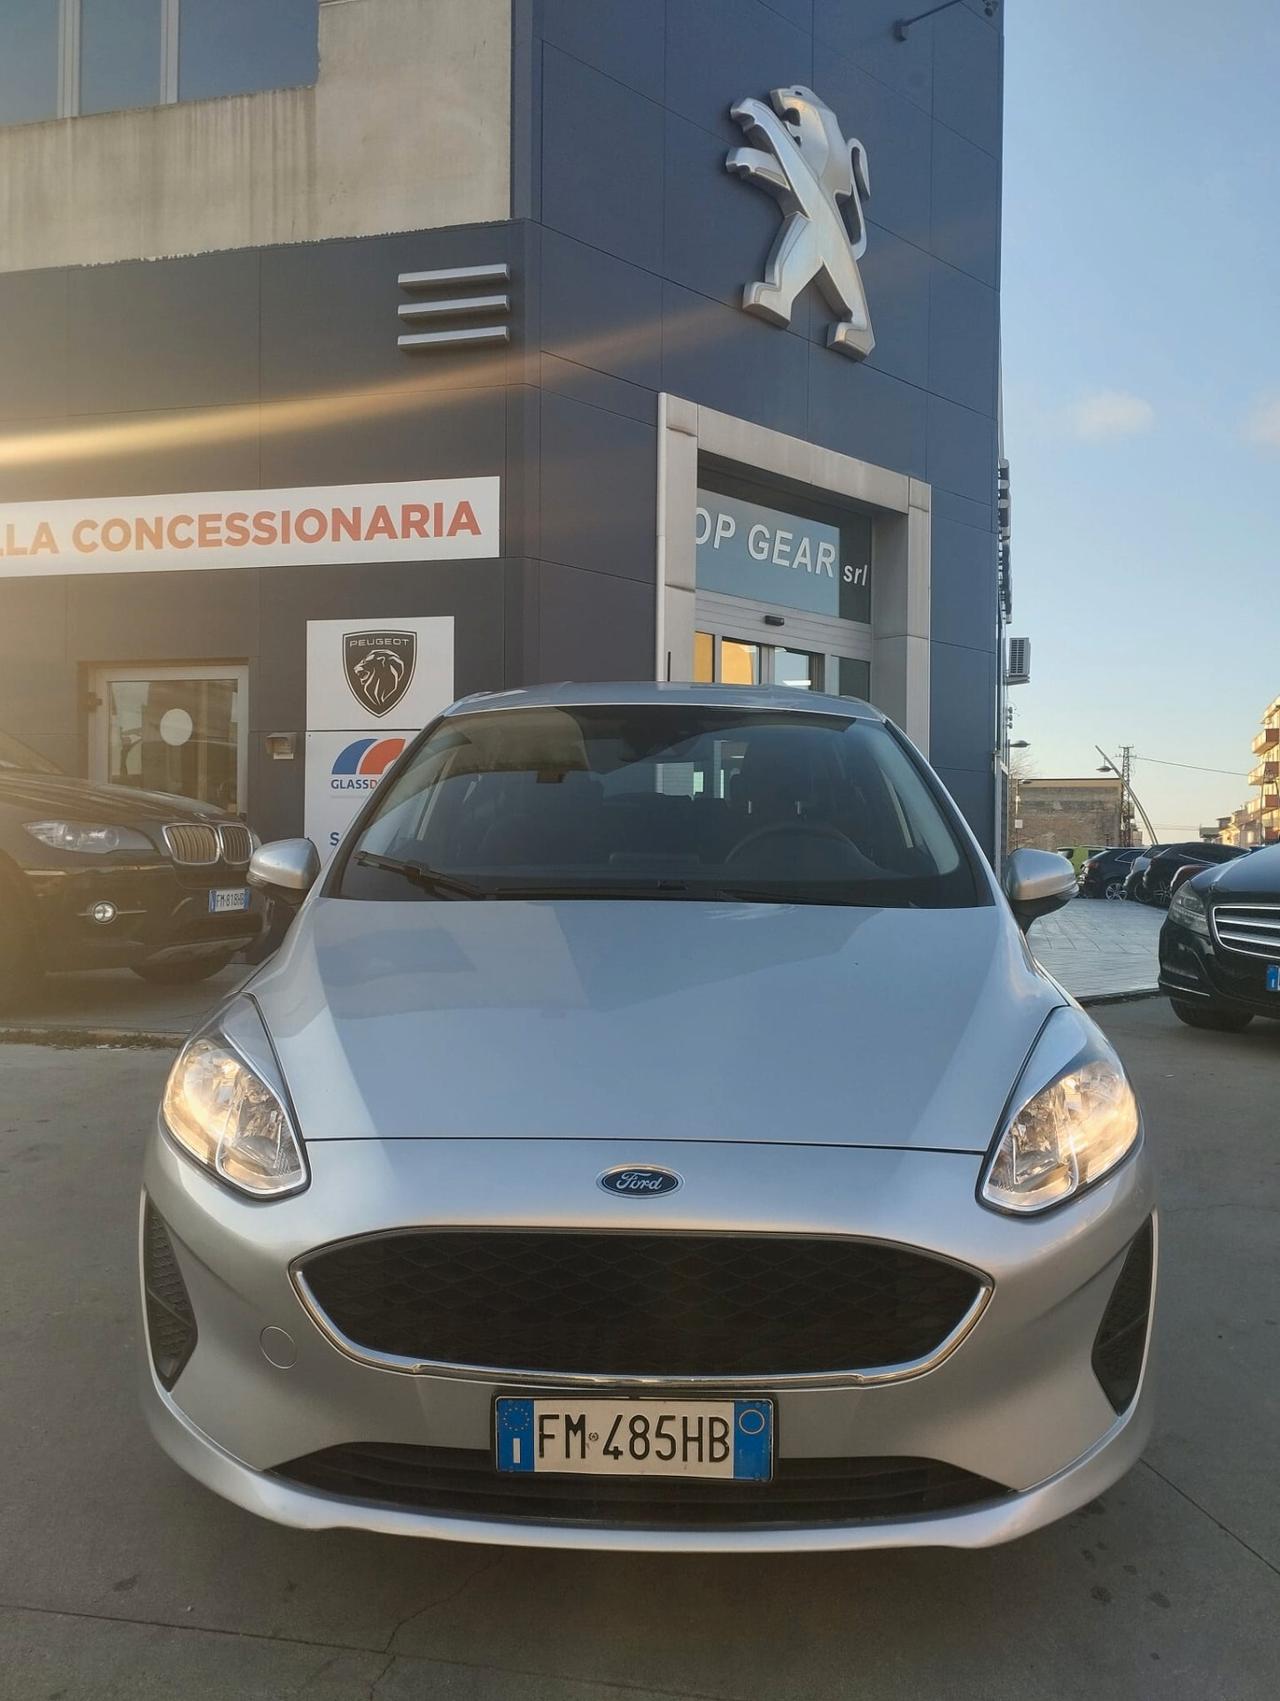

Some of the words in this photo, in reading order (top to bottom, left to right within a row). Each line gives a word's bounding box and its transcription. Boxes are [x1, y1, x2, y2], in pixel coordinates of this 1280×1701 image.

[0, 522, 60, 556] LA
[72, 500, 482, 553] CONCESSIONARIA
[747, 524, 836, 578] GEAR
[842, 564, 868, 586] srl
[349, 638, 409, 647] PEUGEOT
[616, 1172, 663, 1190] Ford
